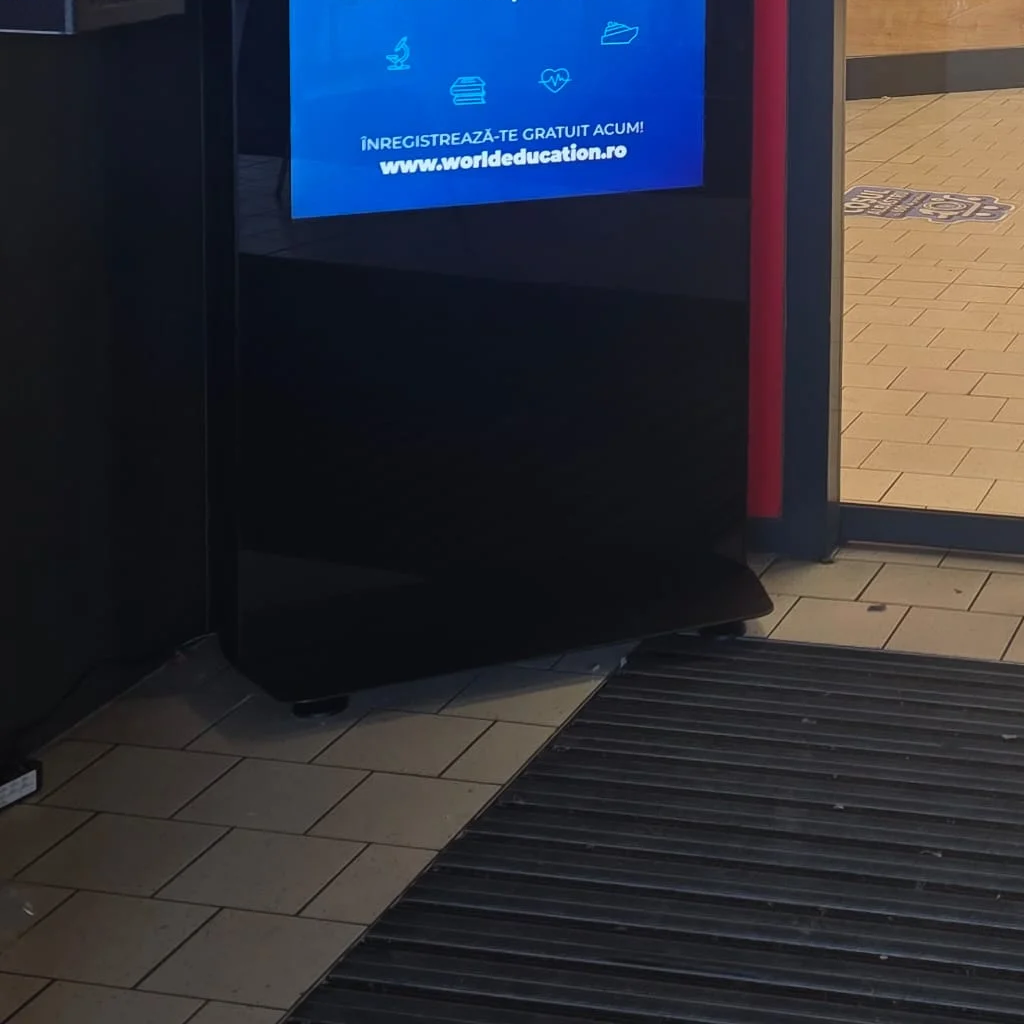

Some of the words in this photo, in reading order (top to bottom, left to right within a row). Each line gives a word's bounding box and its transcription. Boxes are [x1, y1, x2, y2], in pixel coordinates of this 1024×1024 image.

[361, 127, 518, 152] ÎNREGISTREAZĂ-TE
[522, 124, 589, 143] GRATUIT
[593, 121, 645, 137] ACUM!
[380, 144, 627, 175] www.worldeducation.ro
